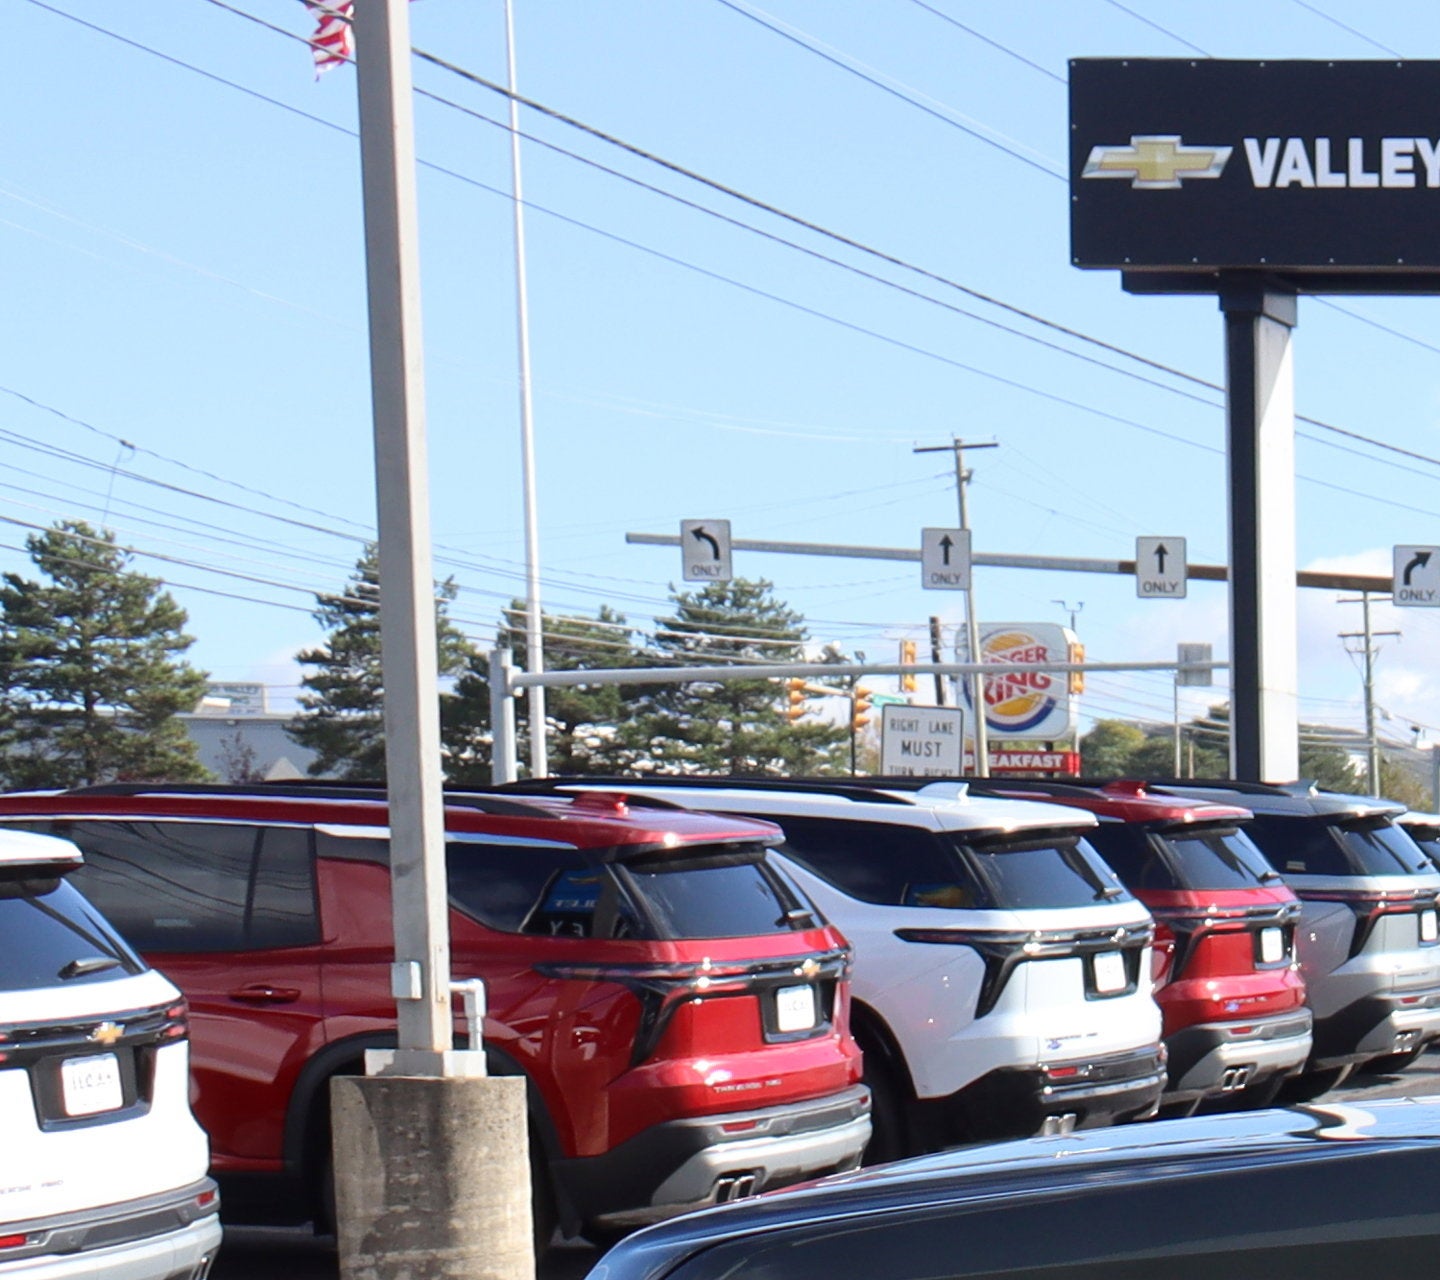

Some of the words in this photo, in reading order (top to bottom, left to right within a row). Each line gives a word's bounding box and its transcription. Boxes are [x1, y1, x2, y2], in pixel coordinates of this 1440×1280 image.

[692, 564, 720, 576] ONLY
[931, 573, 961, 585] ONLY
[1143, 581, 1178, 593] ONLY
[1400, 589, 1435, 601] ONLY
[890, 718, 918, 732] RIGHT
[929, 721, 954, 735] LANE
[901, 741, 942, 757] MUST
[963, 754, 1064, 768] BEAKFAST
